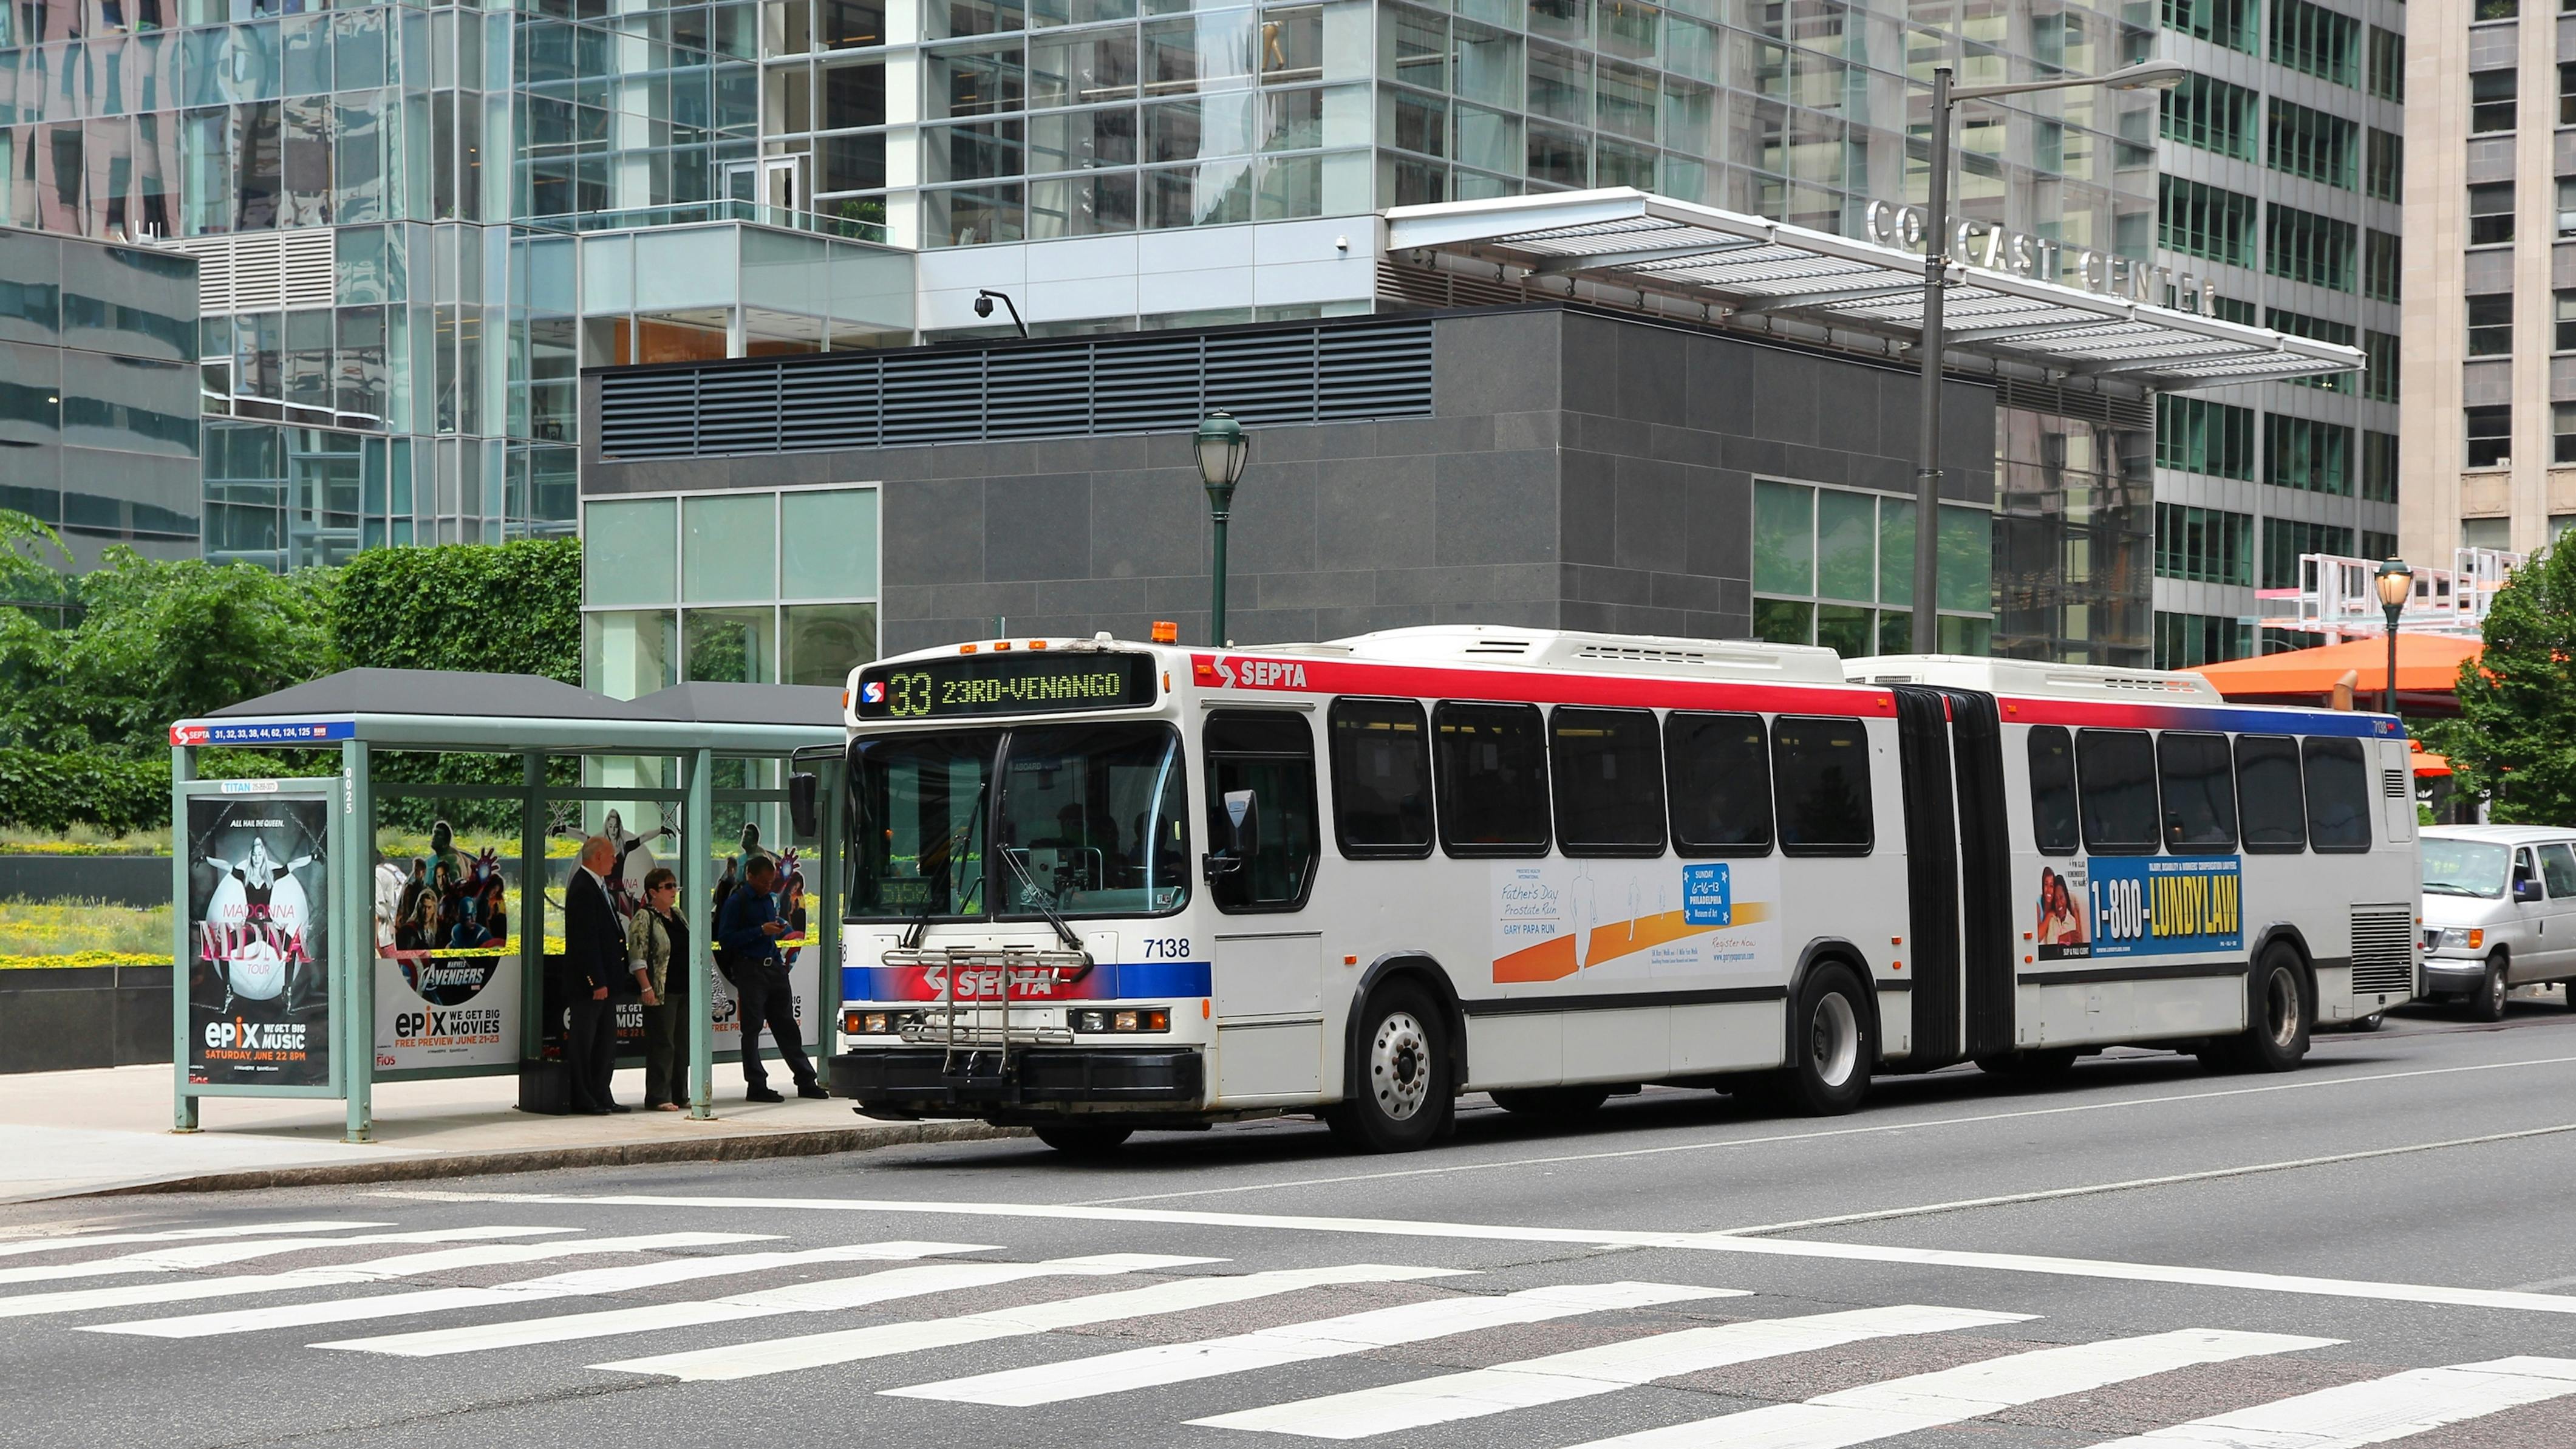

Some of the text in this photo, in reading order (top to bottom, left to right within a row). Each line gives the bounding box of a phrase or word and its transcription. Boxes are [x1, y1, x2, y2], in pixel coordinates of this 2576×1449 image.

[1867, 200, 2217, 316] COCAST CENTER
[1241, 660, 1307, 687] SEPTA
[890, 672, 1120, 716] 33 23RD-VENANGO
[189, 728, 310, 740] SEPTA 31, 32, 33, 38, 44, 62, 124, 125
[2373, 720, 2388, 734] 7138
[224, 782, 251, 792] TITAN
[1695, 870, 1714, 879] SUNDAY
[1502, 884, 1559, 904] Father's Day
[1692, 882, 1719, 895] 6-16-13
[1689, 896, 1722, 904] PHILADELPHIA
[2091, 875, 2238, 938] 1-800-LUNDYLAW
[223, 904, 295, 918] MADONNA
[1505, 902, 1556, 915] Prostate Run
[1504, 924, 1555, 934] GARY PAPA RUN
[198, 920, 315, 963] MDNA
[1143, 938, 1190, 958] 7138
[1712, 936, 1756, 952] Register Now
[247, 964, 270, 975] TOUR
[421, 964, 485, 990] AVENGERS
[957, 969, 1052, 996] SEPTA
[449, 1009, 500, 1020] WE GET BIG
[616, 1004, 642, 1012] WE GET
[450, 1020, 499, 1035] MOVIES
[616, 1013, 643, 1028] MUS
[264, 1024, 306, 1034] WE GET BIG
[262, 1034, 305, 1050] MUSIC
[395, 1038, 415, 1048] FREE
[418, 1037, 453, 1046] PREVIEW
[456, 1035, 477, 1045] JUNE
[205, 1049, 306, 1061] SATURDAY, JUNE 22 8PM
